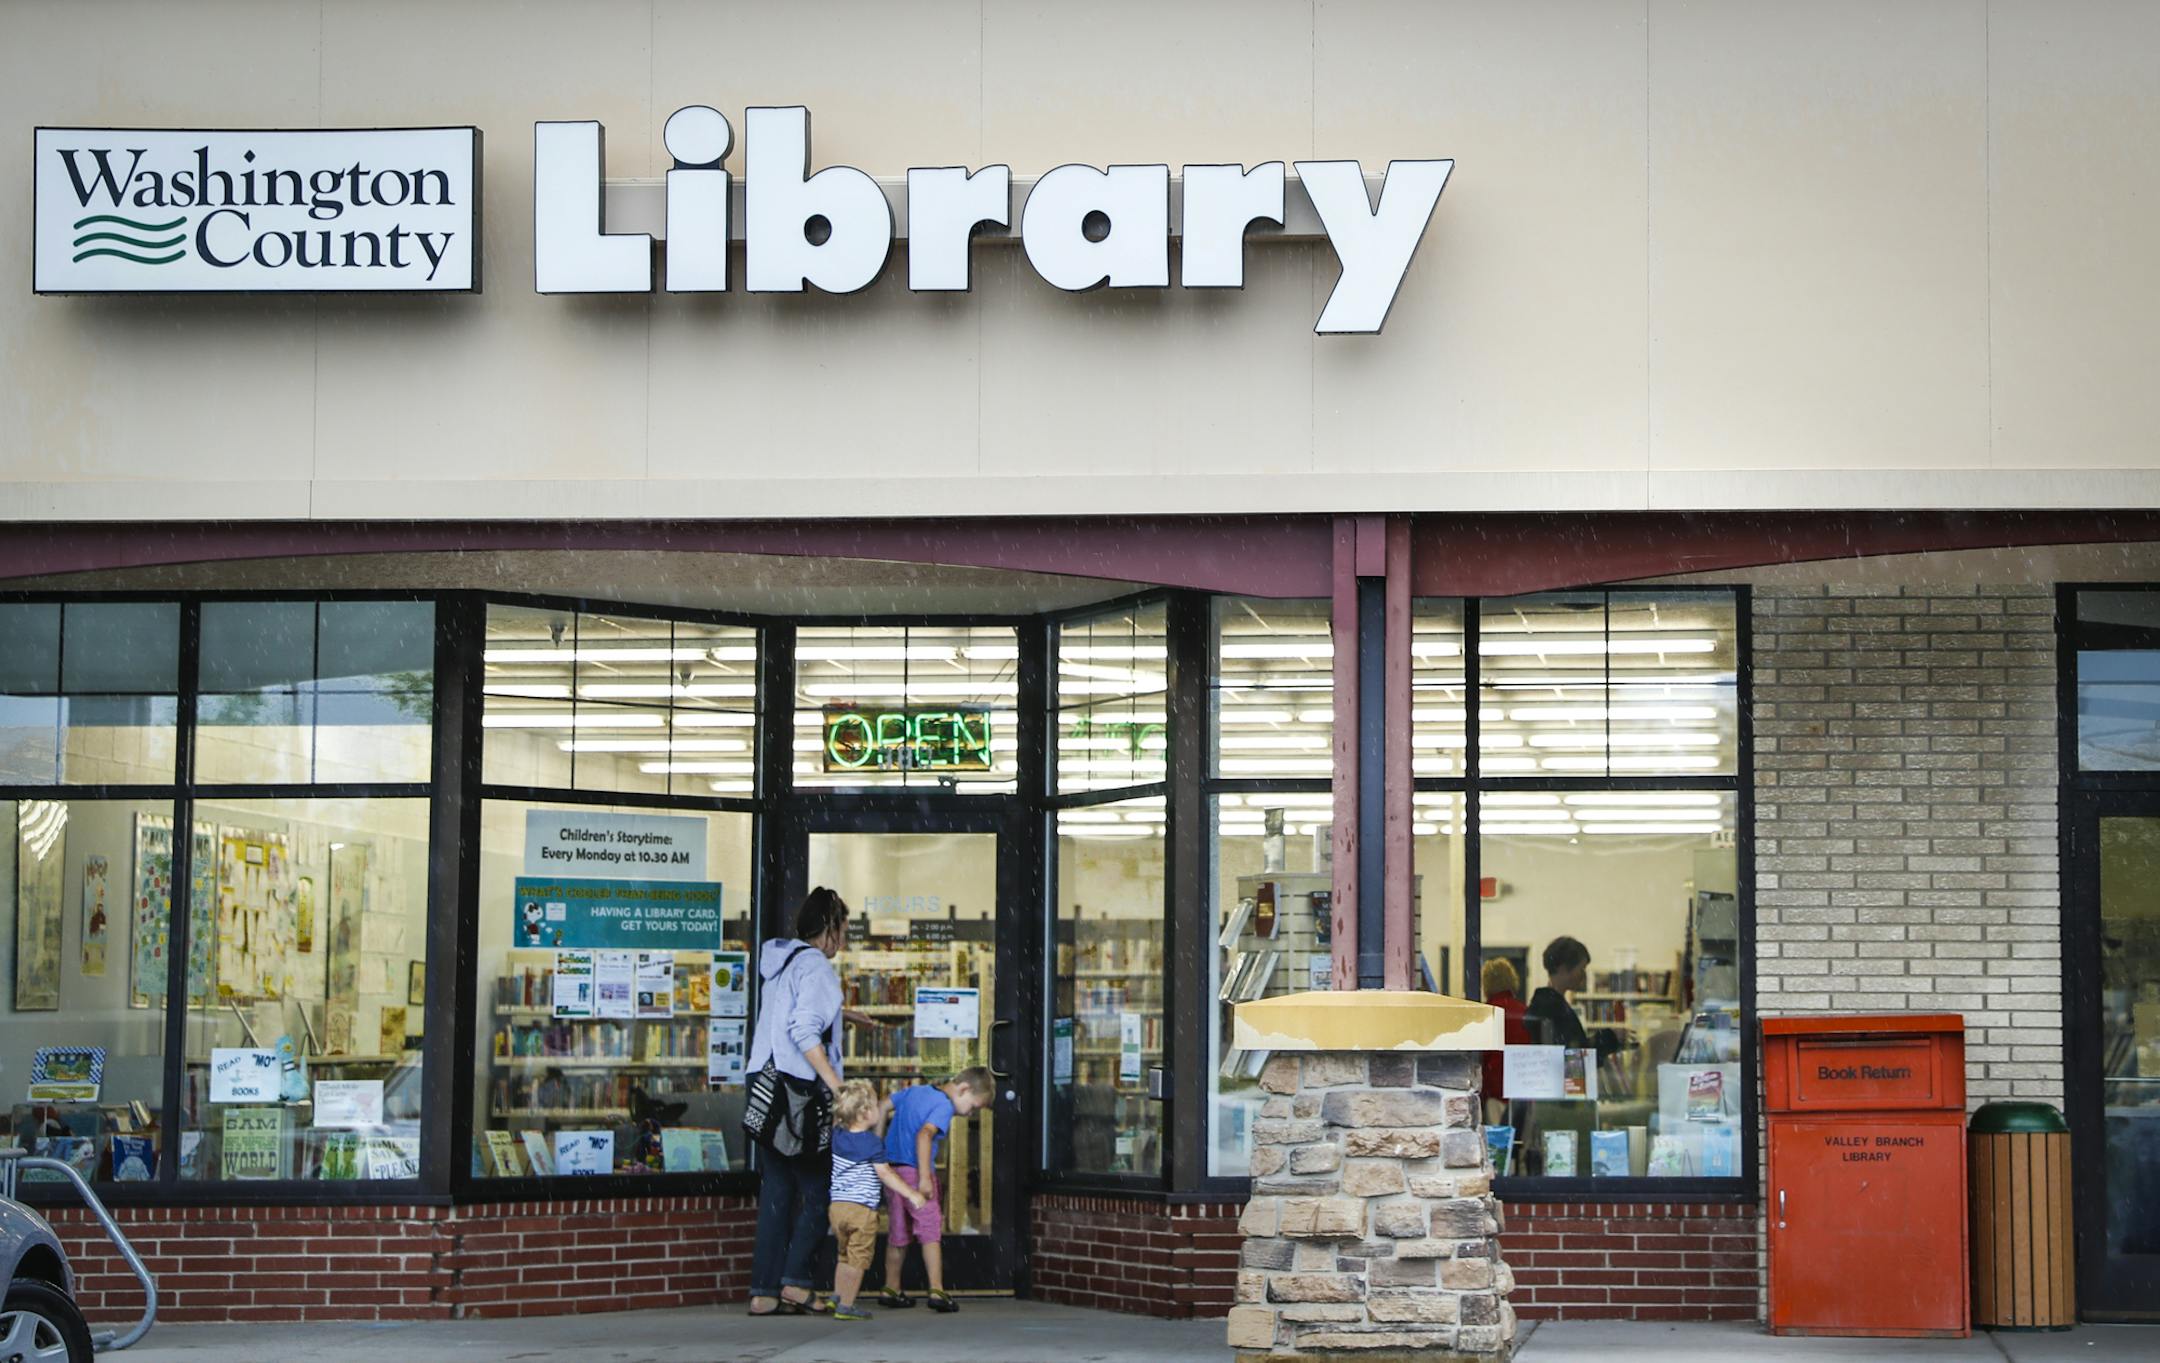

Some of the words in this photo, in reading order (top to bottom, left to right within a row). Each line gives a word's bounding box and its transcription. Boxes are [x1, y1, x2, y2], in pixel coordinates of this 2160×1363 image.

[56, 145, 455, 220] Washington
[534, 105, 1455, 336] Library
[195, 209, 455, 281] County
[828, 712, 990, 768] OPEN
[560, 827, 614, 842] Children's
[617, 831, 673, 846] Storytime:
[541, 846, 573, 862] Every
[576, 847, 620, 864] Monday
[624, 850, 636, 862] at
[671, 851, 690, 864] AM
[591, 906, 631, 918] HAVING
[634, 907, 642, 918] A
[645, 907, 685, 919] LIBRARY
[688, 908, 719, 919] CARD.
[865, 895, 941, 913] HOURS
[621, 919, 641, 931] GET
[645, 920, 678, 932] YOURS
[681, 920, 718, 932] TODAY!
[217, 1056, 241, 1074] READ
[1818, 1066, 1857, 1080] Book
[1861, 1065, 1911, 1080] Return
[232, 1087, 259, 1096] BOOKS
[226, 1117, 278, 1130] SAM
[1825, 1136, 1869, 1147] VALLEY
[1876, 1136, 1924, 1147] BRANCH
[225, 1151, 277, 1174] WORLD
[1843, 1152, 1892, 1162] LIBRARY
